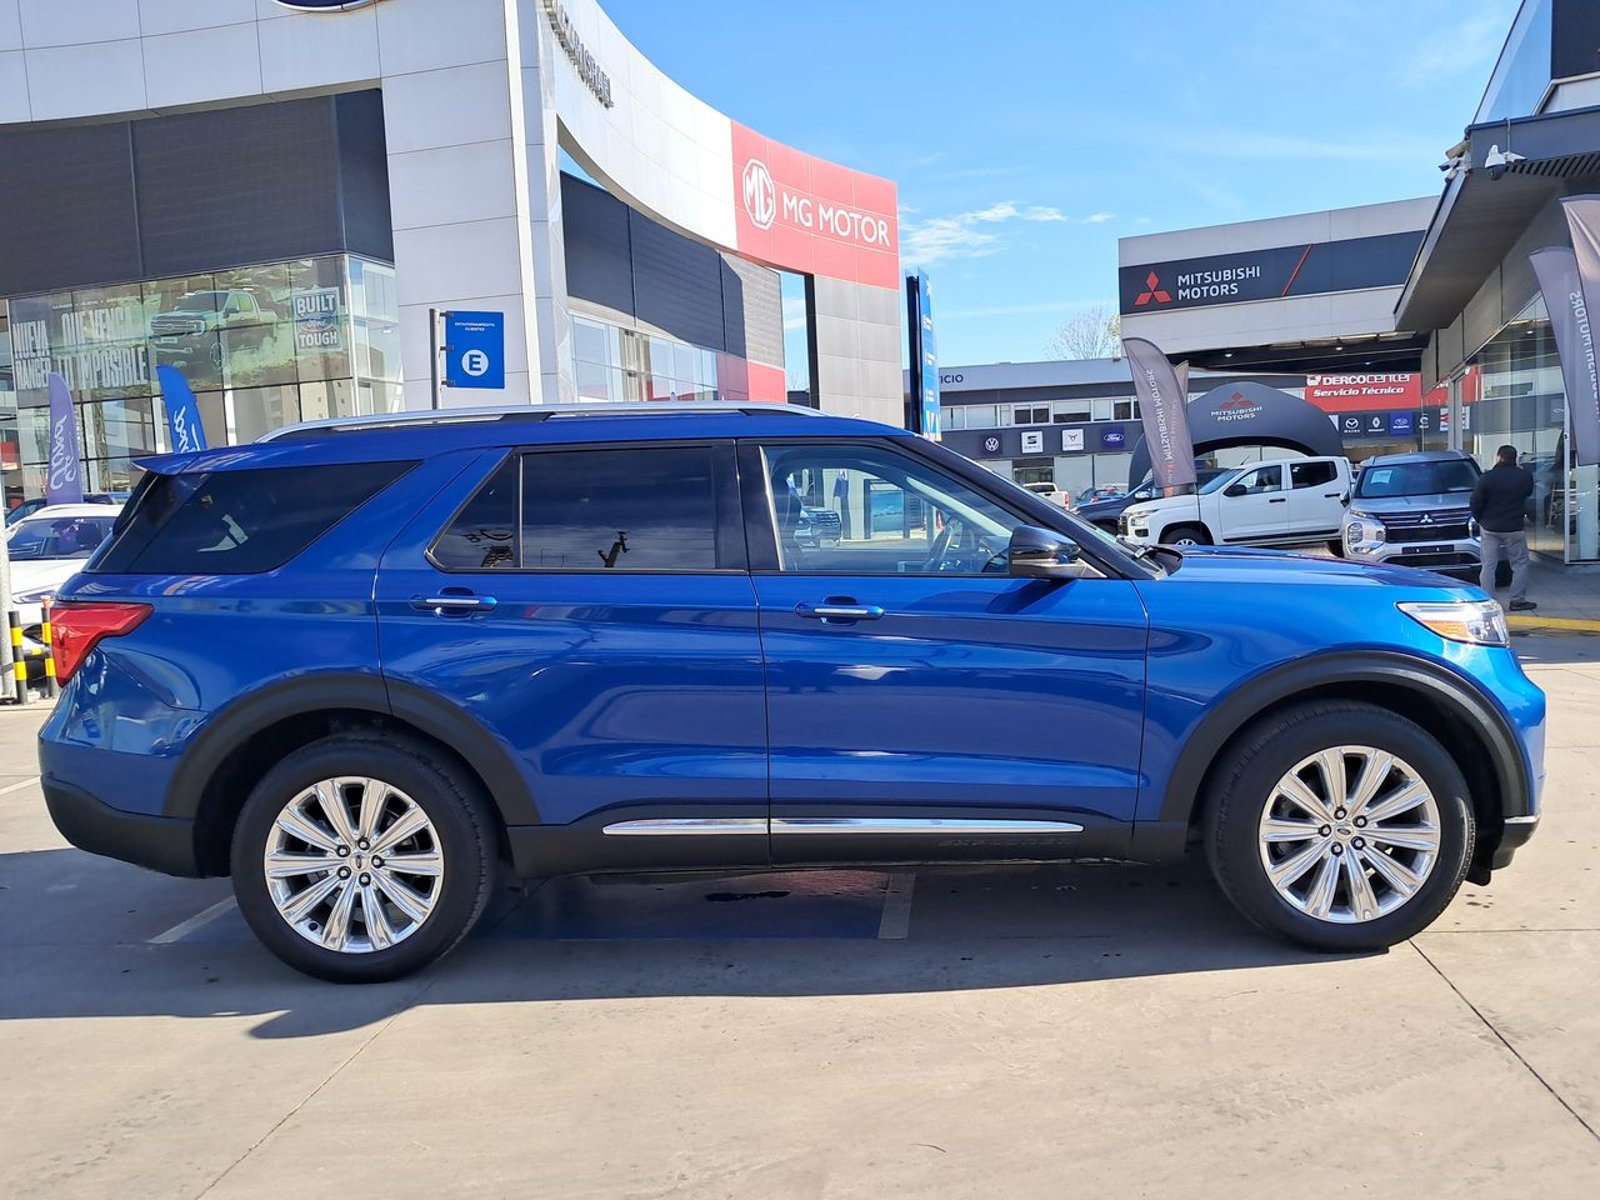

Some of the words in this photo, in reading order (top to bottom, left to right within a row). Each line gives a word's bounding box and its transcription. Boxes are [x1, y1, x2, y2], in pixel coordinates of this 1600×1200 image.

[782, 191, 813, 227] MG
[818, 203, 890, 247] MOTOR
[1177, 265, 1261, 287] MITSUBISHI
[1178, 283, 1239, 301] MOTORS
[296, 295, 335, 315] BUILT
[12, 319, 51, 359] NUEVA
[299, 331, 337, 347] TOUGH
[77, 346, 149, 391] IMPOSIBLE
[469, 354, 481, 371] E
[939, 374, 964, 384] ICIO
[1313, 388, 1360, 397] Servicio
[1361, 386, 1405, 396] Técnico
[1210, 406, 1263, 417] MITSUBISHI
[1217, 412, 1256, 421] MOTORS
